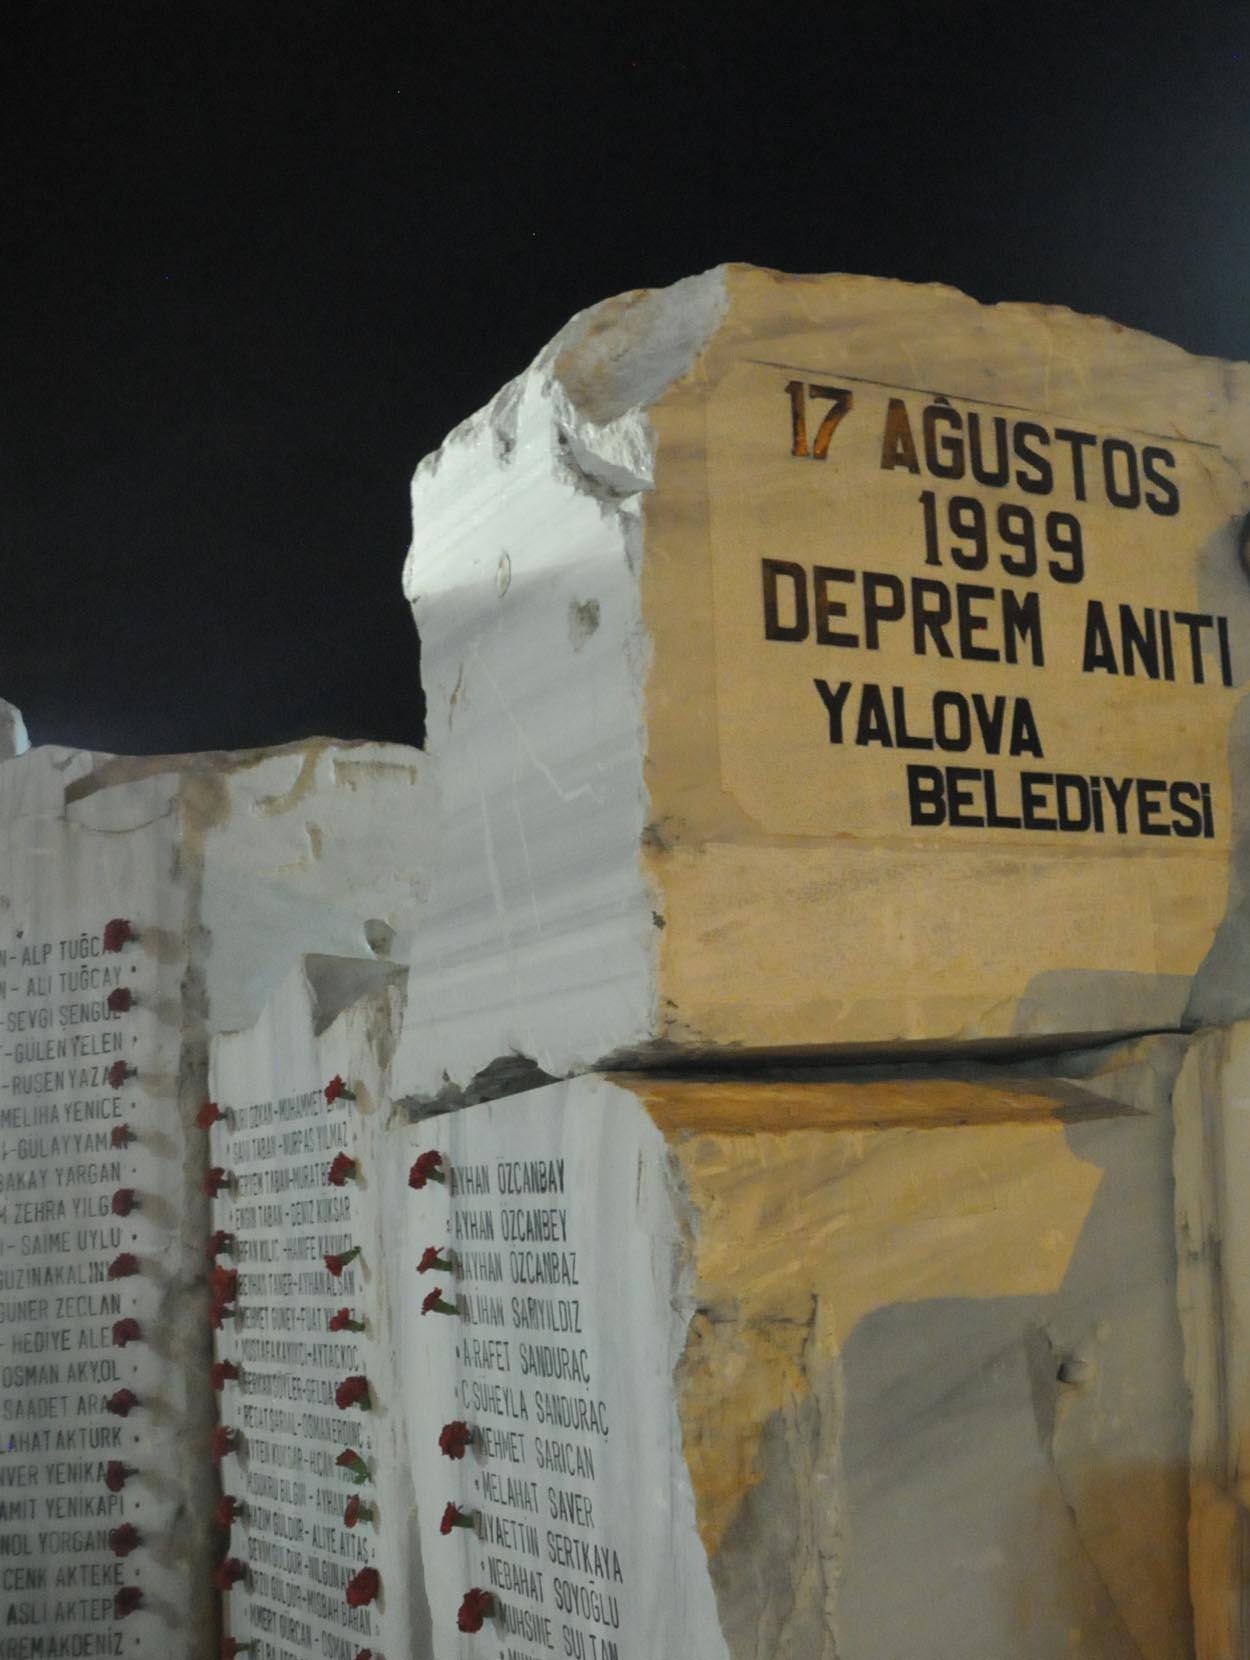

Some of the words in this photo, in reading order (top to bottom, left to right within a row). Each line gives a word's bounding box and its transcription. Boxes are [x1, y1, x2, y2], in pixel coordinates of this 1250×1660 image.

[785, 379, 853, 460] 17
[880, 396, 1181, 517] AĞUSTOS
[918, 491, 1086, 585] 1999
[761, 557, 1045, 668] DEPREM
[1081, 599, 1233, 688] ANITI
[813, 678, 1045, 759] YALOVA
[906, 764, 1215, 840] BELEDİYESİ
[21, 943, 53, 967] ALP
[69, 1032, 123, 1057] YELEN
[55, 1161, 122, 1188] YARGAN
[14, 1199, 67, 1224] ZEHRA
[455, 1208, 495, 1241] AYHAN
[2, 1363, 60, 1388] OSMAN
[3, 1396, 72, 1421] SAADET
[481, 1425, 526, 1464] MEHMET
[535, 1436, 596, 1480] SARICAN
[482, 1471, 540, 1513] MELAHAT
[548, 1487, 596, 1529] SAVER
[3, 1567, 48, 1591] CENK
[56, 1563, 125, 1588] AKTEKE
[546, 1530, 624, 1585] SERTKAYA
[7, 1600, 48, 1626] ASLI
[488, 1556, 545, 1604] NEBAHAT
[553, 1578, 620, 1630] SOYOĞLU
